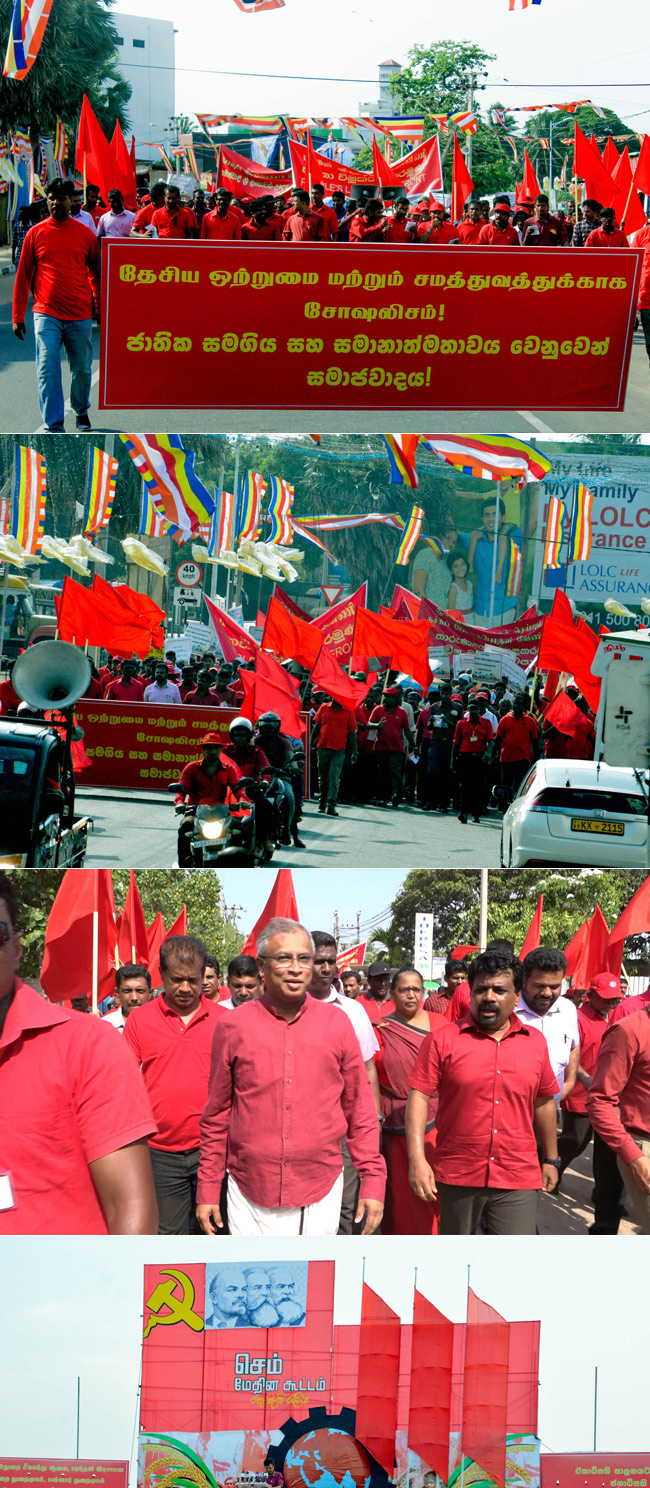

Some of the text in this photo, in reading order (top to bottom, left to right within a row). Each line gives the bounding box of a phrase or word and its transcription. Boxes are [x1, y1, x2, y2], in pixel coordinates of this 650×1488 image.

[119, 264, 627, 292] தேசிய ஒற்றுமை மற்றும் சமத்துவத்துக்காக
[304, 301, 445, 322] சோஷலிசம்!
[126, 331, 610, 360] ජාතික සමගිය සහ සමානාත්මතාවය වෙනුවෙන්
[306, 366, 431, 391] සමාජවාදය!
[588, 483, 639, 503] amily
[183, 565, 195, 573] 40
[581, 563, 640, 578] LOLC LIFE
[580, 579, 650, 594] ASSURAN
[234, 1352, 283, 1375] செம்
[234, 1376, 326, 1395] மேதின கூட்டம்
